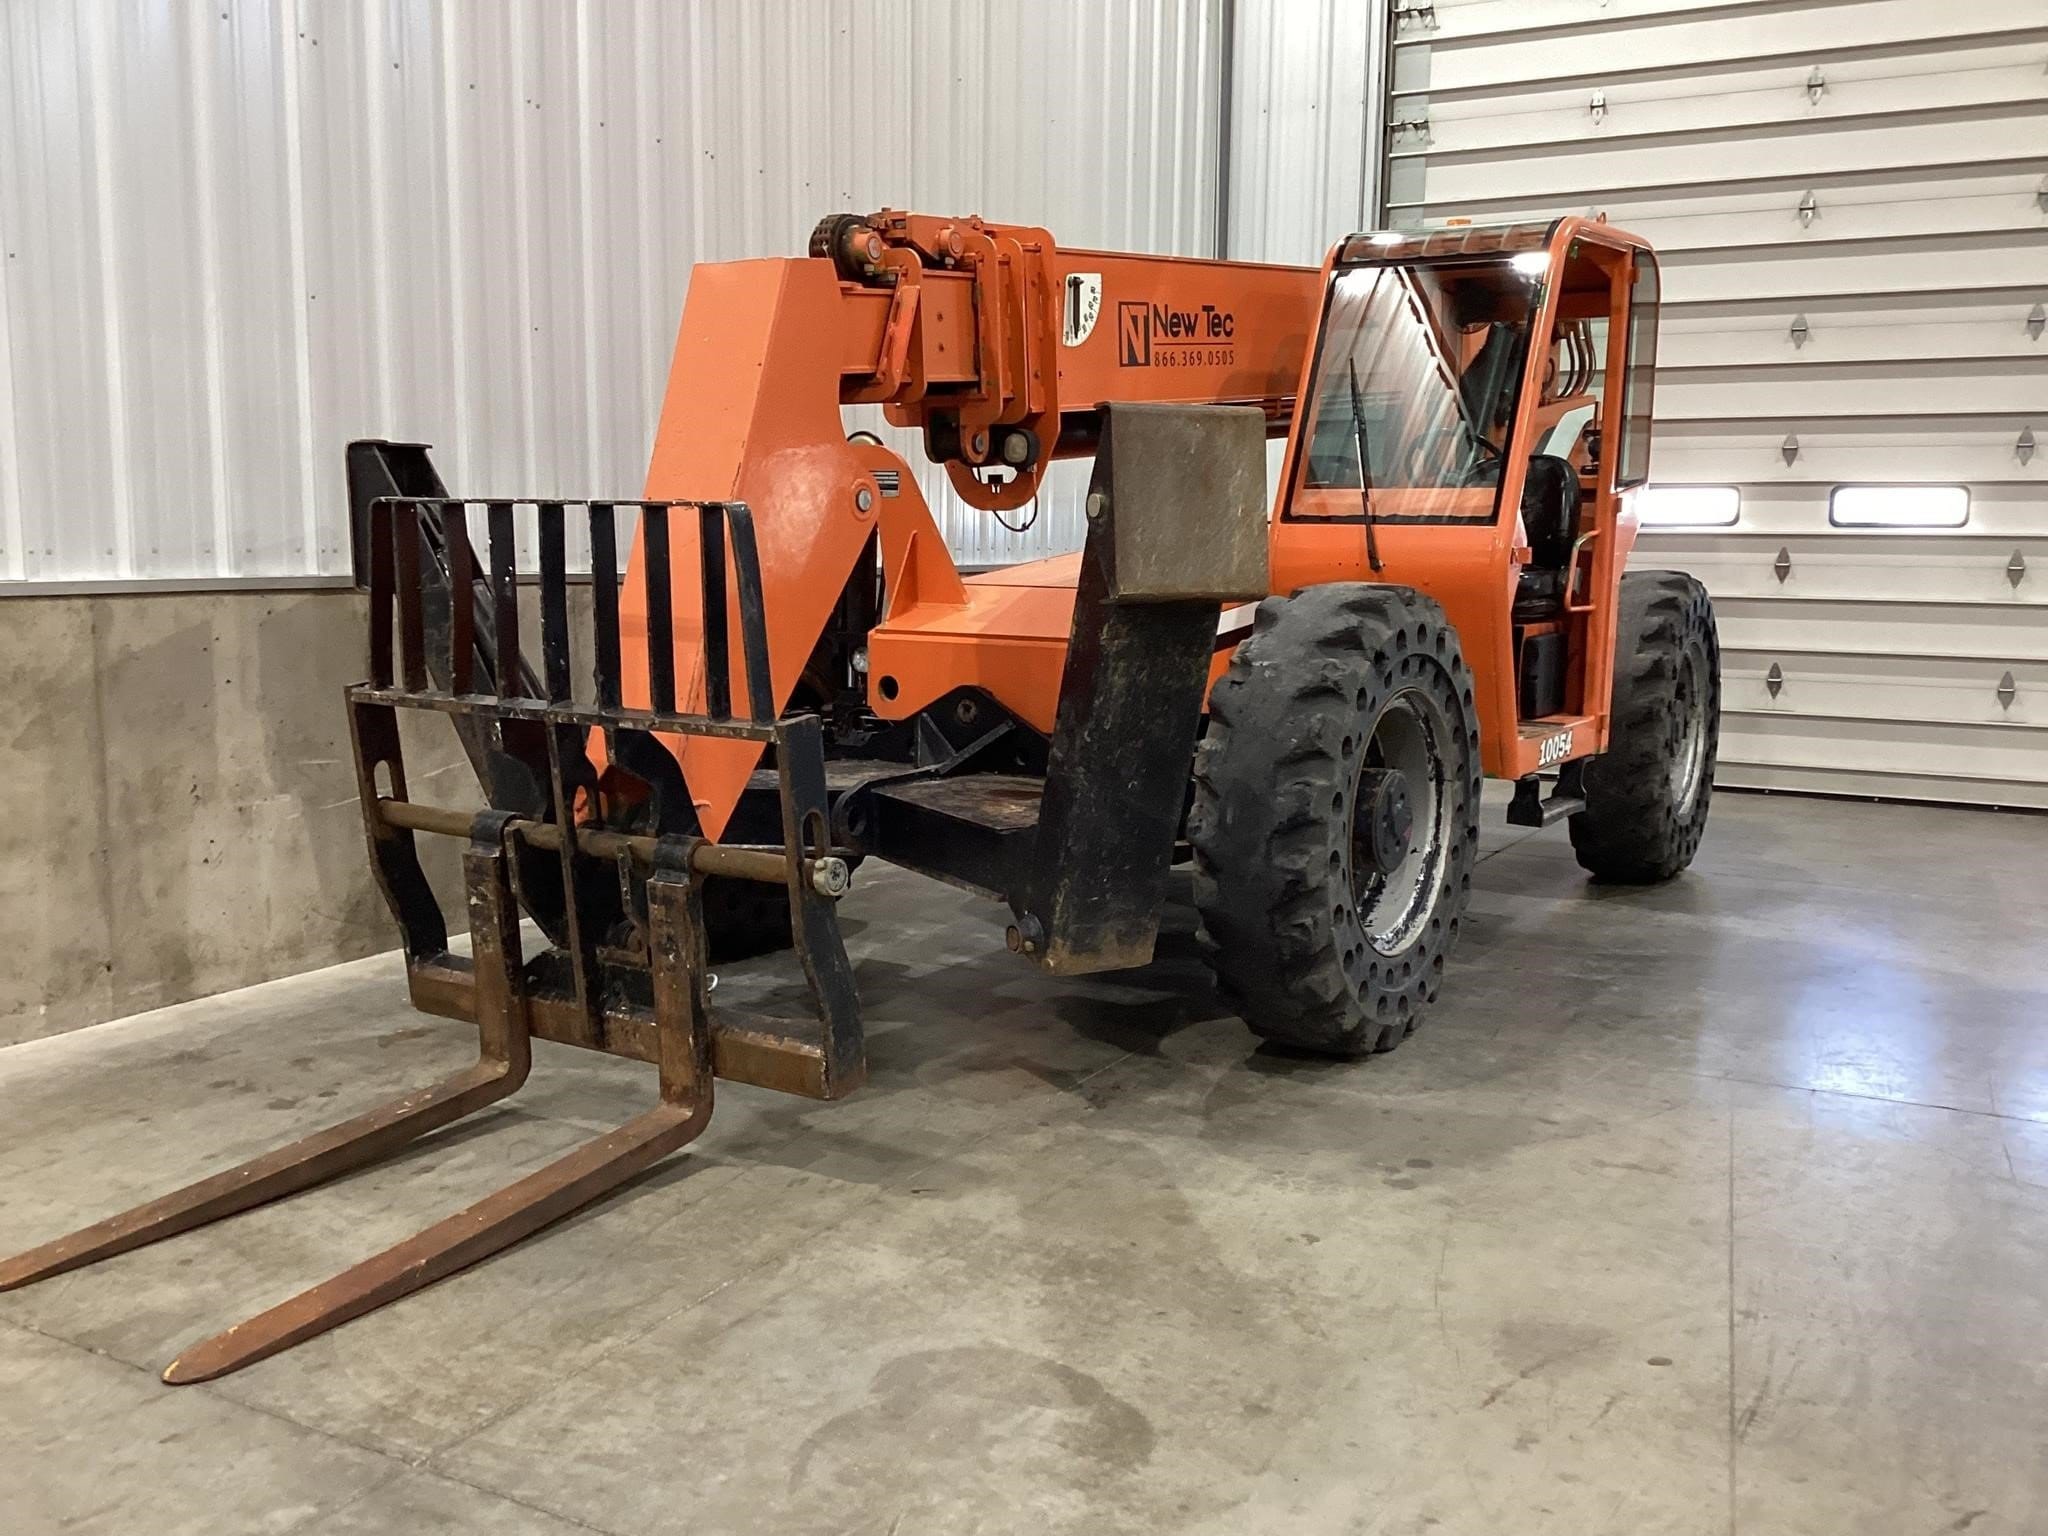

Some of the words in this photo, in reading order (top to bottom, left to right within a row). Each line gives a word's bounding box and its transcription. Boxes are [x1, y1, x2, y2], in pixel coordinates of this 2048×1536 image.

[1153, 304, 1198, 337] New
[1202, 305, 1234, 337] Tec
[1154, 350, 1234, 367] 866.369.0505
[1538, 730, 1572, 765] 10054
